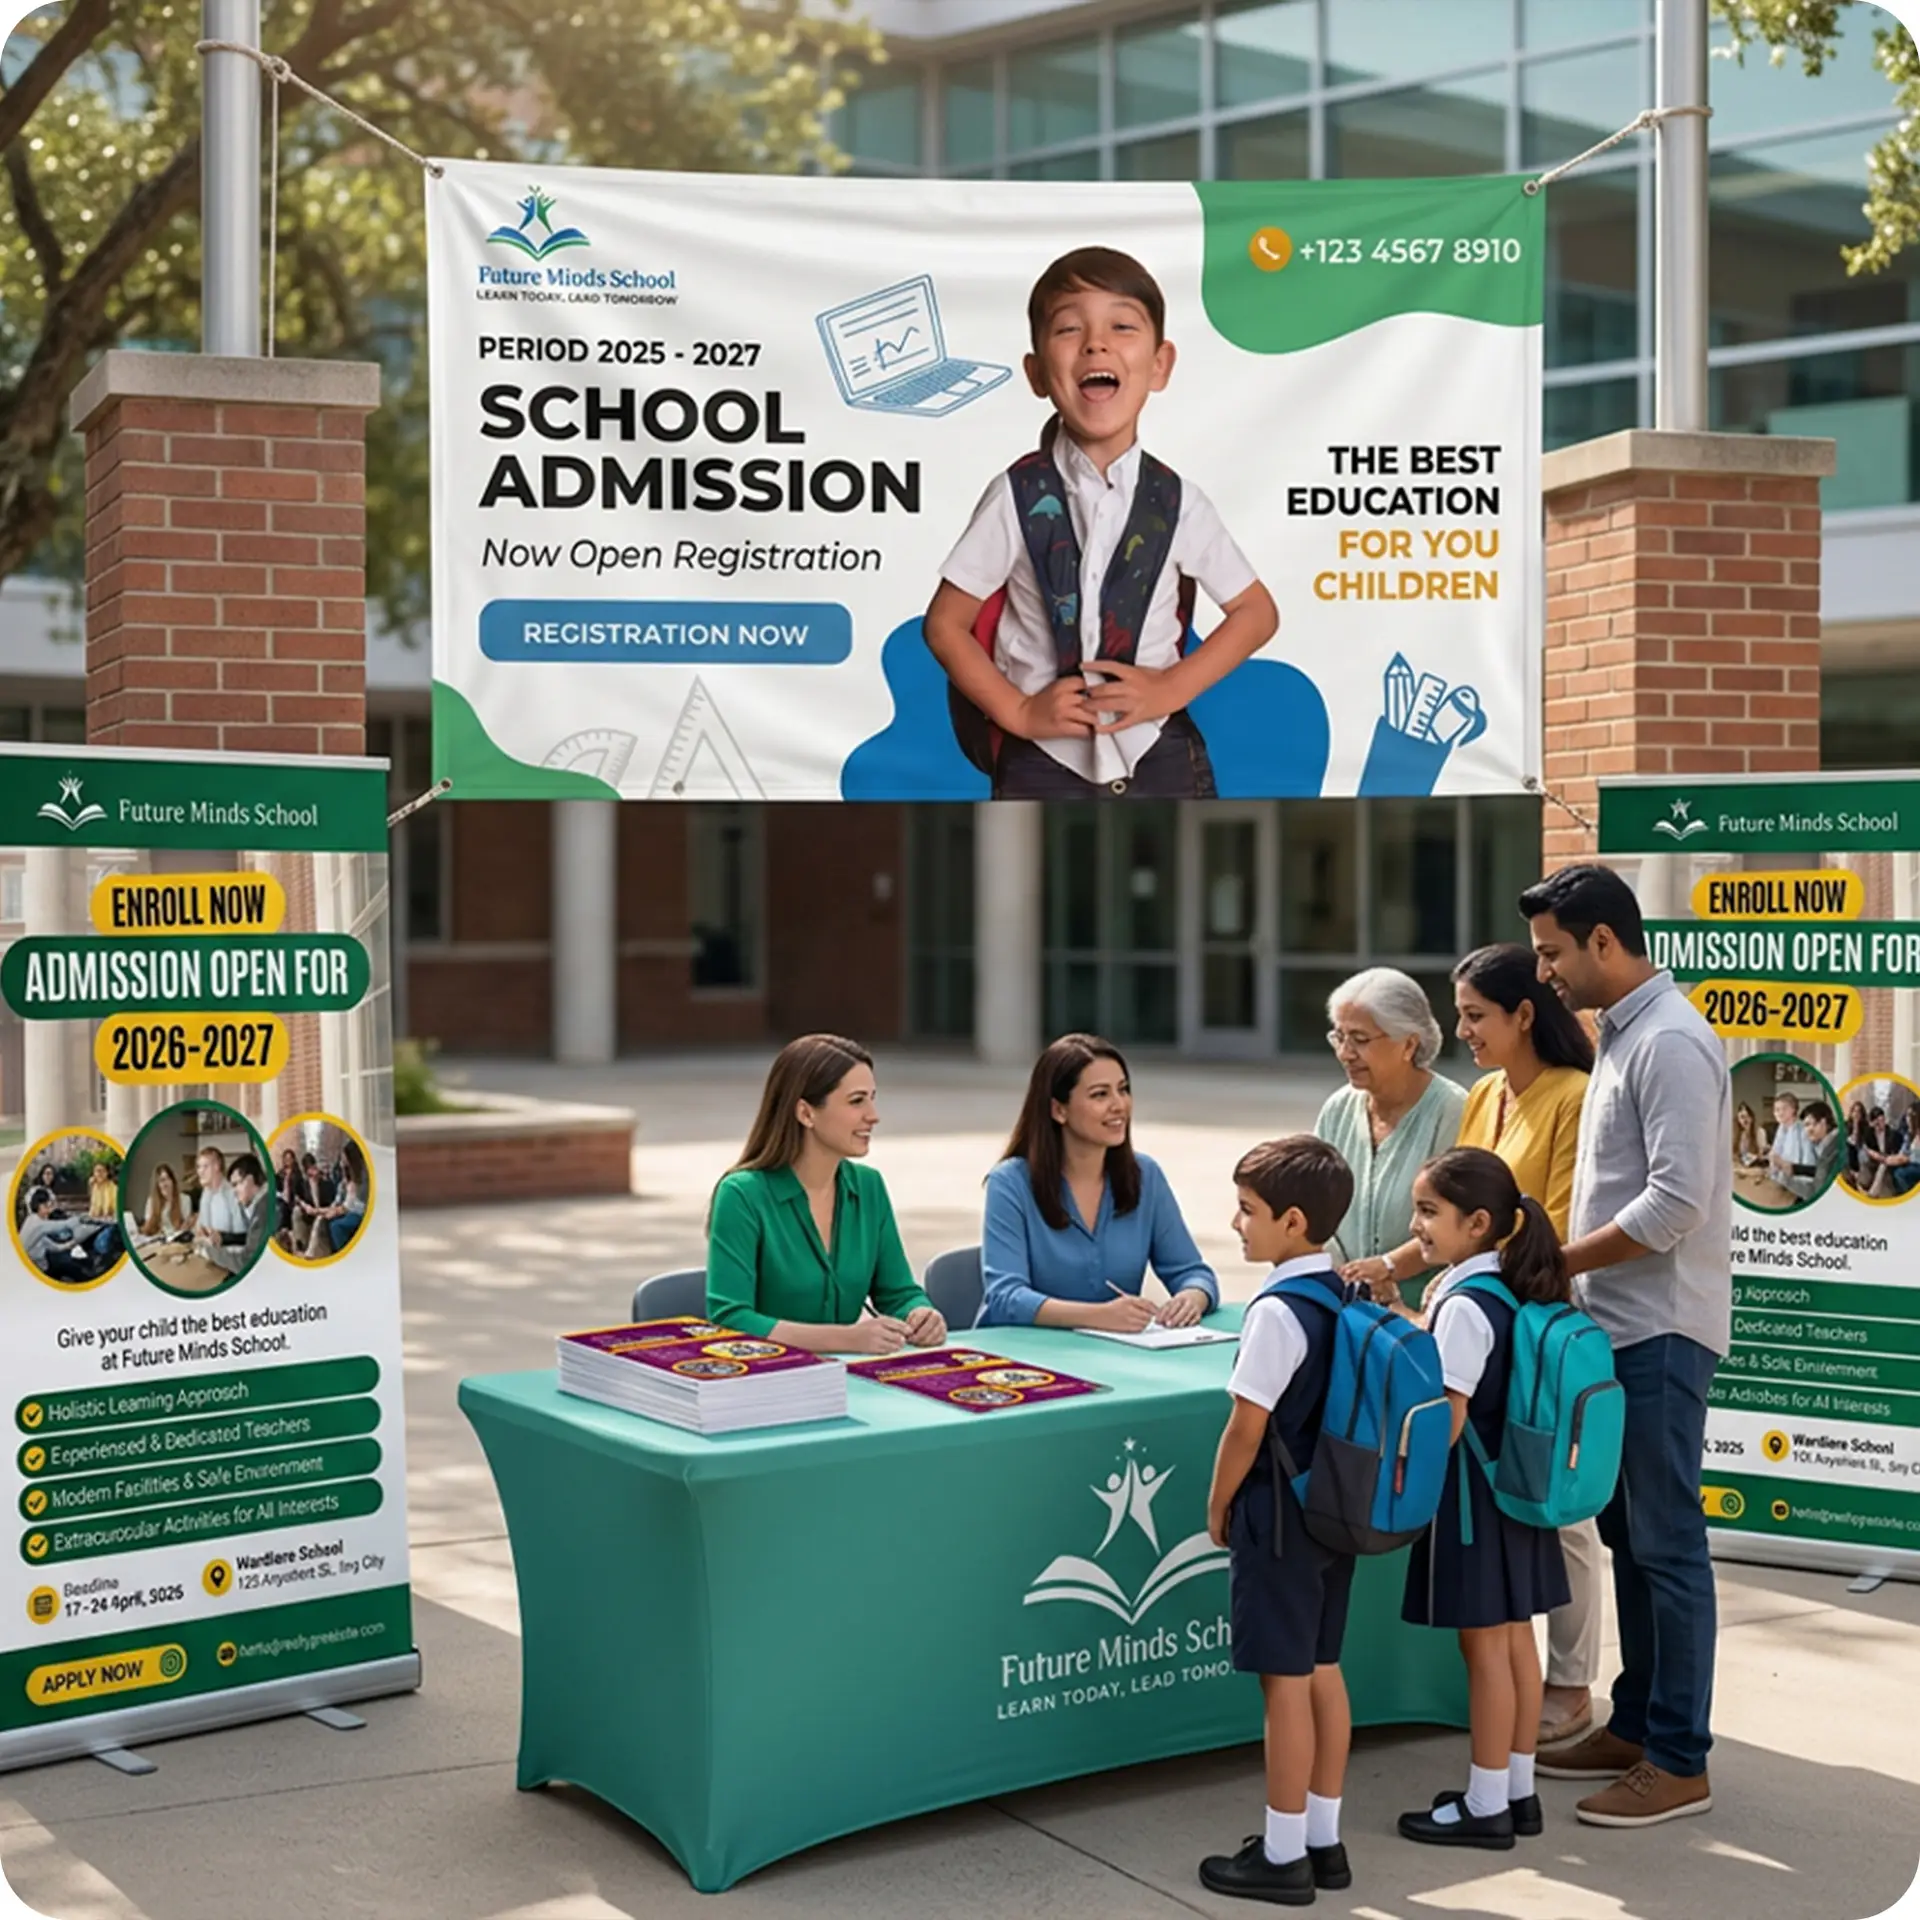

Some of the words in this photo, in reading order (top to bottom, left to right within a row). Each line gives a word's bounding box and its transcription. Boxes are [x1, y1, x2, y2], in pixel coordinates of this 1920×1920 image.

[1300, 238, 1361, 264] +123
[1371, 238, 1444, 264] 4567
[1453, 238, 1521, 264] 8910
[610, 269, 676, 289] School
[478, 336, 589, 363] PERIOD
[598, 339, 665, 364] 2025
[692, 342, 761, 367] 2027
[479, 385, 806, 444] SCHOOL
[1328, 446, 1399, 475] THE
[1410, 446, 1501, 475] BEST
[479, 454, 921, 514] ADMISSION
[1287, 487, 1500, 517] EDUCATION
[482, 538, 563, 568] Now
[570, 539, 662, 575] Open
[673, 540, 882, 577] Registration
[1339, 529, 1412, 559] FOR
[1422, 529, 1499, 559] YOU
[1313, 570, 1499, 601] CHILDREN
[738, 624, 809, 646] NOW
[119, 799, 185, 824] Future
[191, 802, 250, 825] Minds
[254, 803, 318, 827] School
[1718, 814, 1775, 833] Future
[1779, 813, 1833, 832] Minds
[1837, 811, 1898, 832] School
[112, 886, 204, 928] ENROLL
[209, 884, 265, 925] NOW
[1709, 881, 1789, 915] ENROLL
[1794, 879, 1847, 913] NOW
[1792, 932, 1862, 973] OPEN
[1871, 934, 1920, 974] FOR
[24, 949, 201, 1003] ADMISSION
[209, 948, 286, 998] OPEN
[294, 948, 348, 996] FOR
[1704, 989, 1849, 1030] 2026-2027
[112, 1024, 274, 1071] 2026-2027
[1752, 1226, 1776, 1244] the
[1779, 1228, 1811, 1246] best
[1814, 1231, 1888, 1251] education
[1749, 1248, 1793, 1267] Minds
[57, 1328, 94, 1349] Give
[98, 1324, 134, 1349] your
[138, 1317, 178, 1339] child
[182, 1315, 208, 1335] the
[212, 1311, 246, 1332] best
[250, 1303, 327, 1327] education
[101, 1353, 118, 1370] at
[122, 1346, 174, 1369] Future
[179, 1340, 228, 1362] Minds
[48, 1398, 106, 1421] Holistic
[150, 1433, 162, 1452] &
[183, 1472, 194, 1490] &
[233, 1504, 254, 1523] for
[256, 1501, 273, 1520] All
[279, 1495, 339, 1516] Interests
[1001, 1649, 1091, 1688] Future
[1098, 1627, 1178, 1671] Minds
[1185, 1615, 1232, 1653] Sch
[42, 1669, 97, 1693] APPLY
[101, 1660, 143, 1683] NOW
[997, 1695, 1056, 1720] LEARN
[1063, 1681, 1126, 1707] TODAY,
[1131, 1671, 1175, 1694] LEAD
[1182, 1660, 1237, 1682] TOMO
